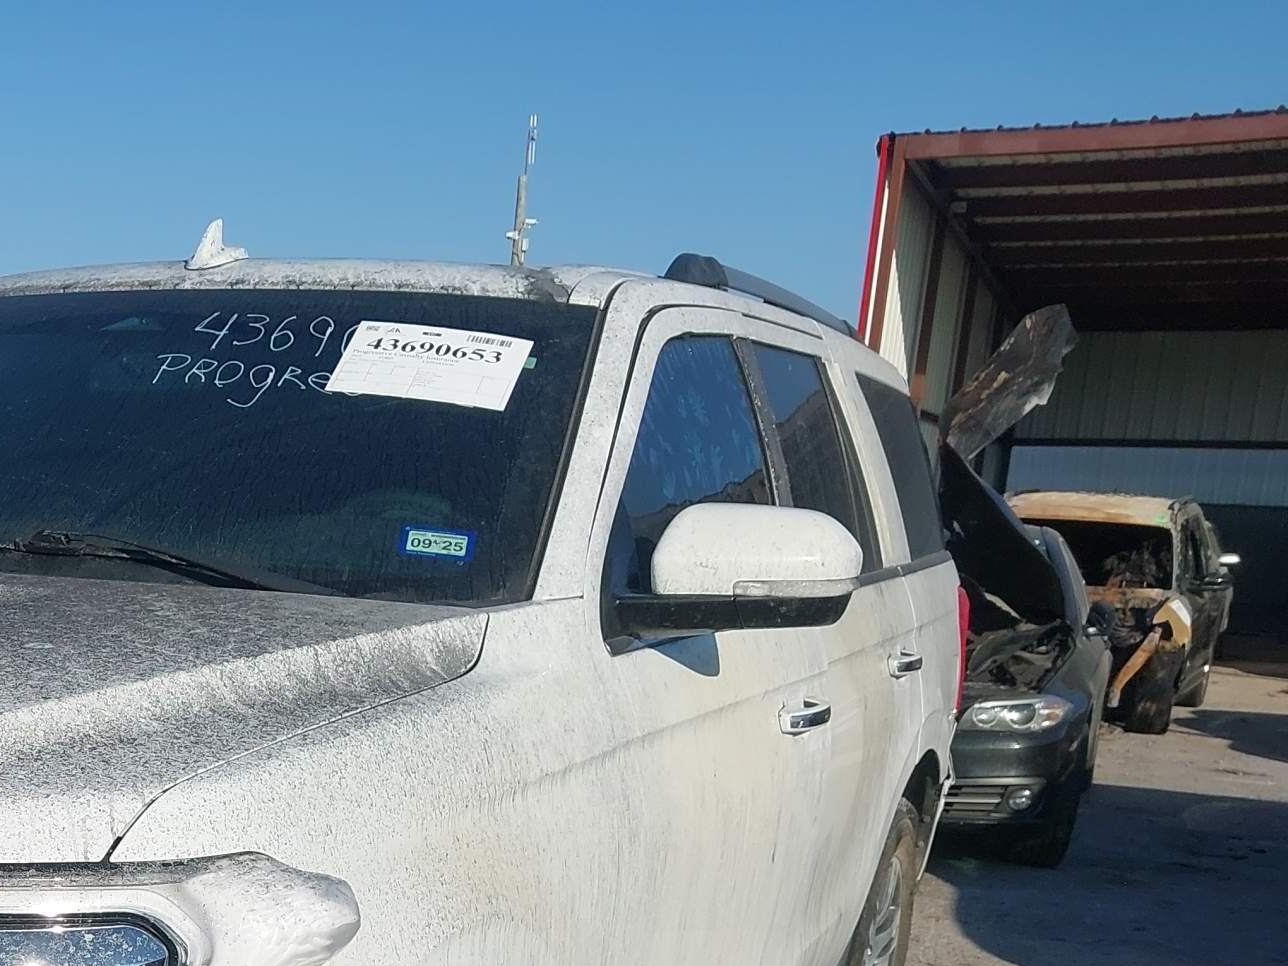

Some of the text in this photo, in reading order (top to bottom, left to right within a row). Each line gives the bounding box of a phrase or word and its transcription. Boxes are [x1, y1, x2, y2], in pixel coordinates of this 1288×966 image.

[367, 336, 503, 364] 43690653
[411, 537, 465, 553] 09 25
